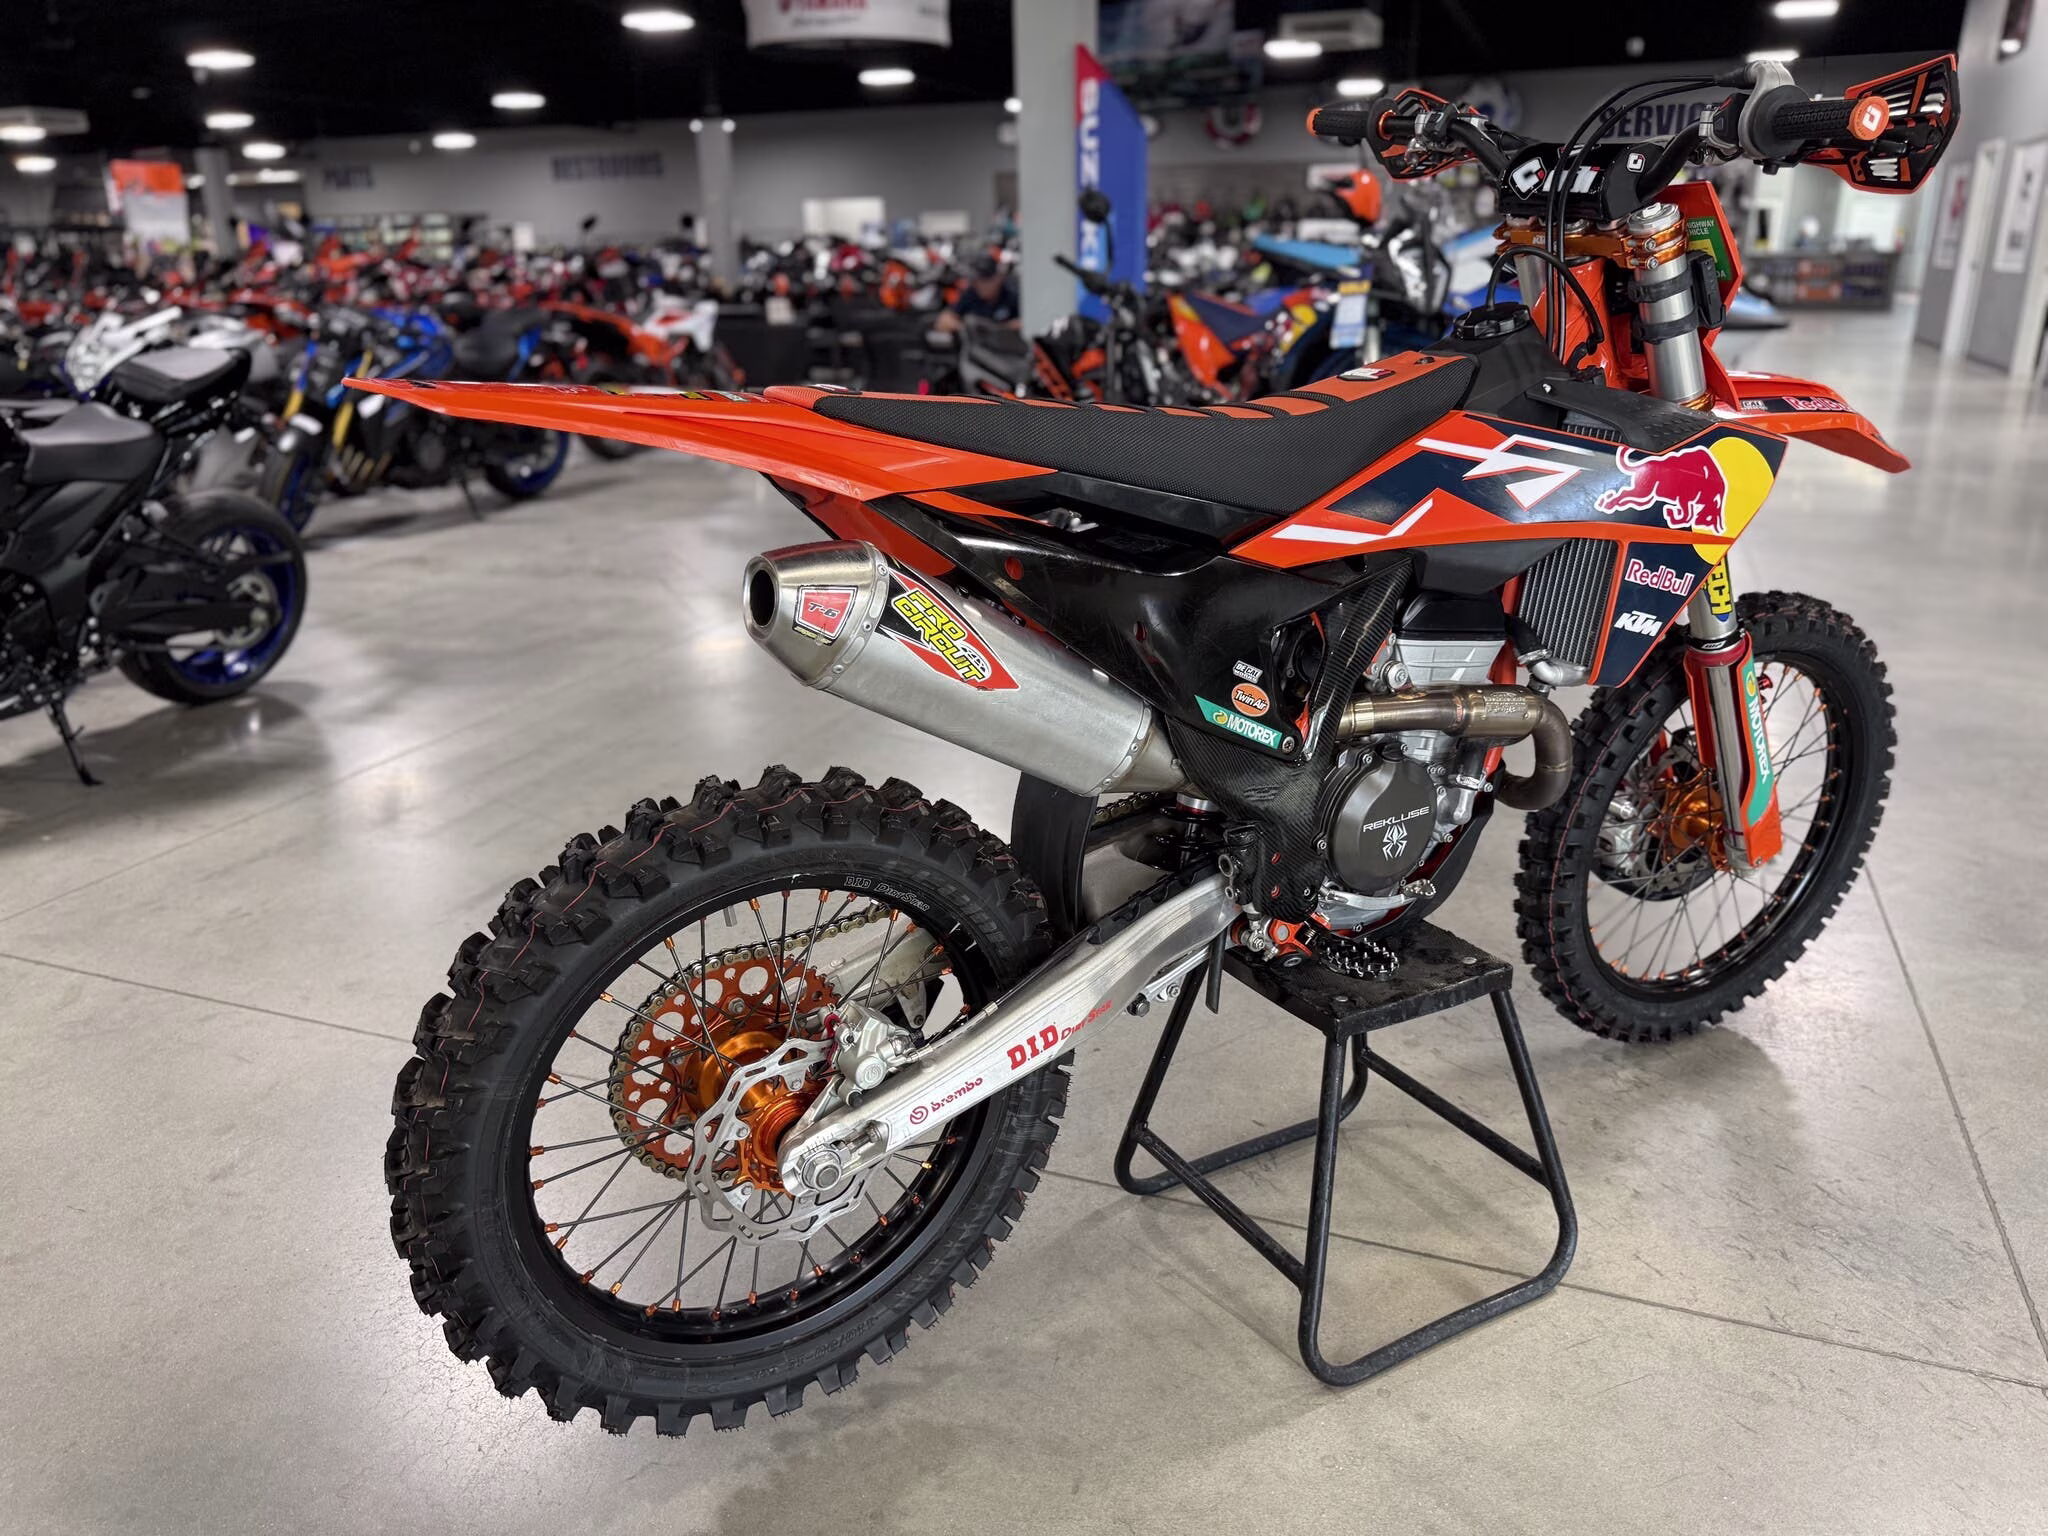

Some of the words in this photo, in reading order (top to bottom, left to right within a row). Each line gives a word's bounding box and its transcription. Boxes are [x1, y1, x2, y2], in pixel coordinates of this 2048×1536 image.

[1079, 77, 1099, 270] SUZKI
[1706, 555, 1732, 614] ECH
[808, 602, 840, 618] T-6
[907, 589, 966, 641] PRO
[1613, 610, 1662, 637] KTM
[893, 596, 985, 680] CIRCUIT
[1236, 690, 1255, 707] Twin
[1253, 697, 1268, 711] Air
[1227, 713, 1278, 747] MOTOREX
[1748, 695, 1771, 784] MOTOREX
[1362, 806, 1430, 832] REKLUSE
[931, 1076, 984, 1112] brembo
